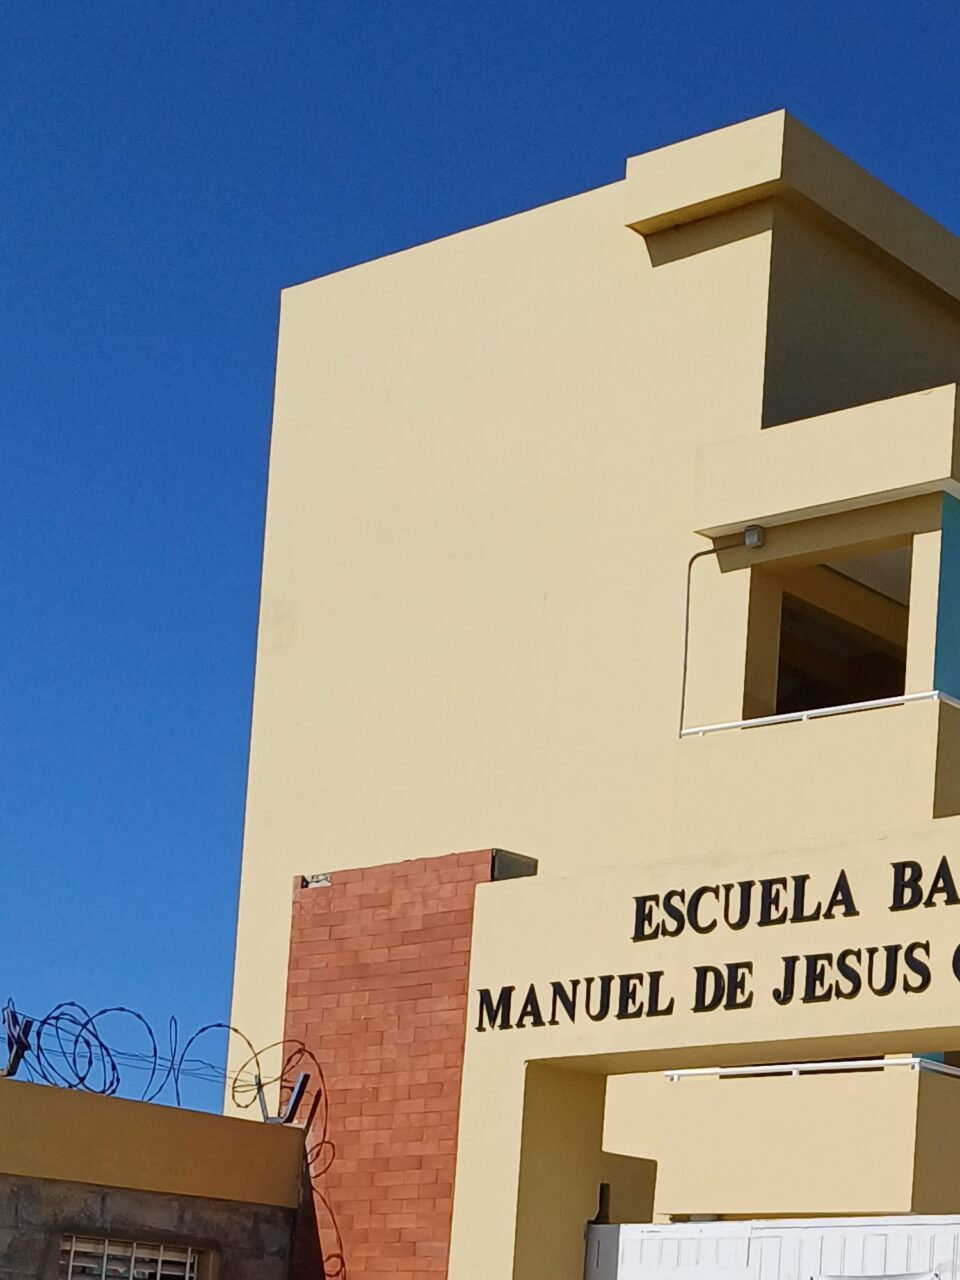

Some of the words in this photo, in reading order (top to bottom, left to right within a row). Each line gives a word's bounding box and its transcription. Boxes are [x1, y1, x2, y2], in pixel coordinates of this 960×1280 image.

[630, 869, 860, 943] ESCUELA
[475, 970, 676, 1032] MANUEL
[690, 961, 754, 1014] DE
[772, 939, 932, 1006] JESUS
